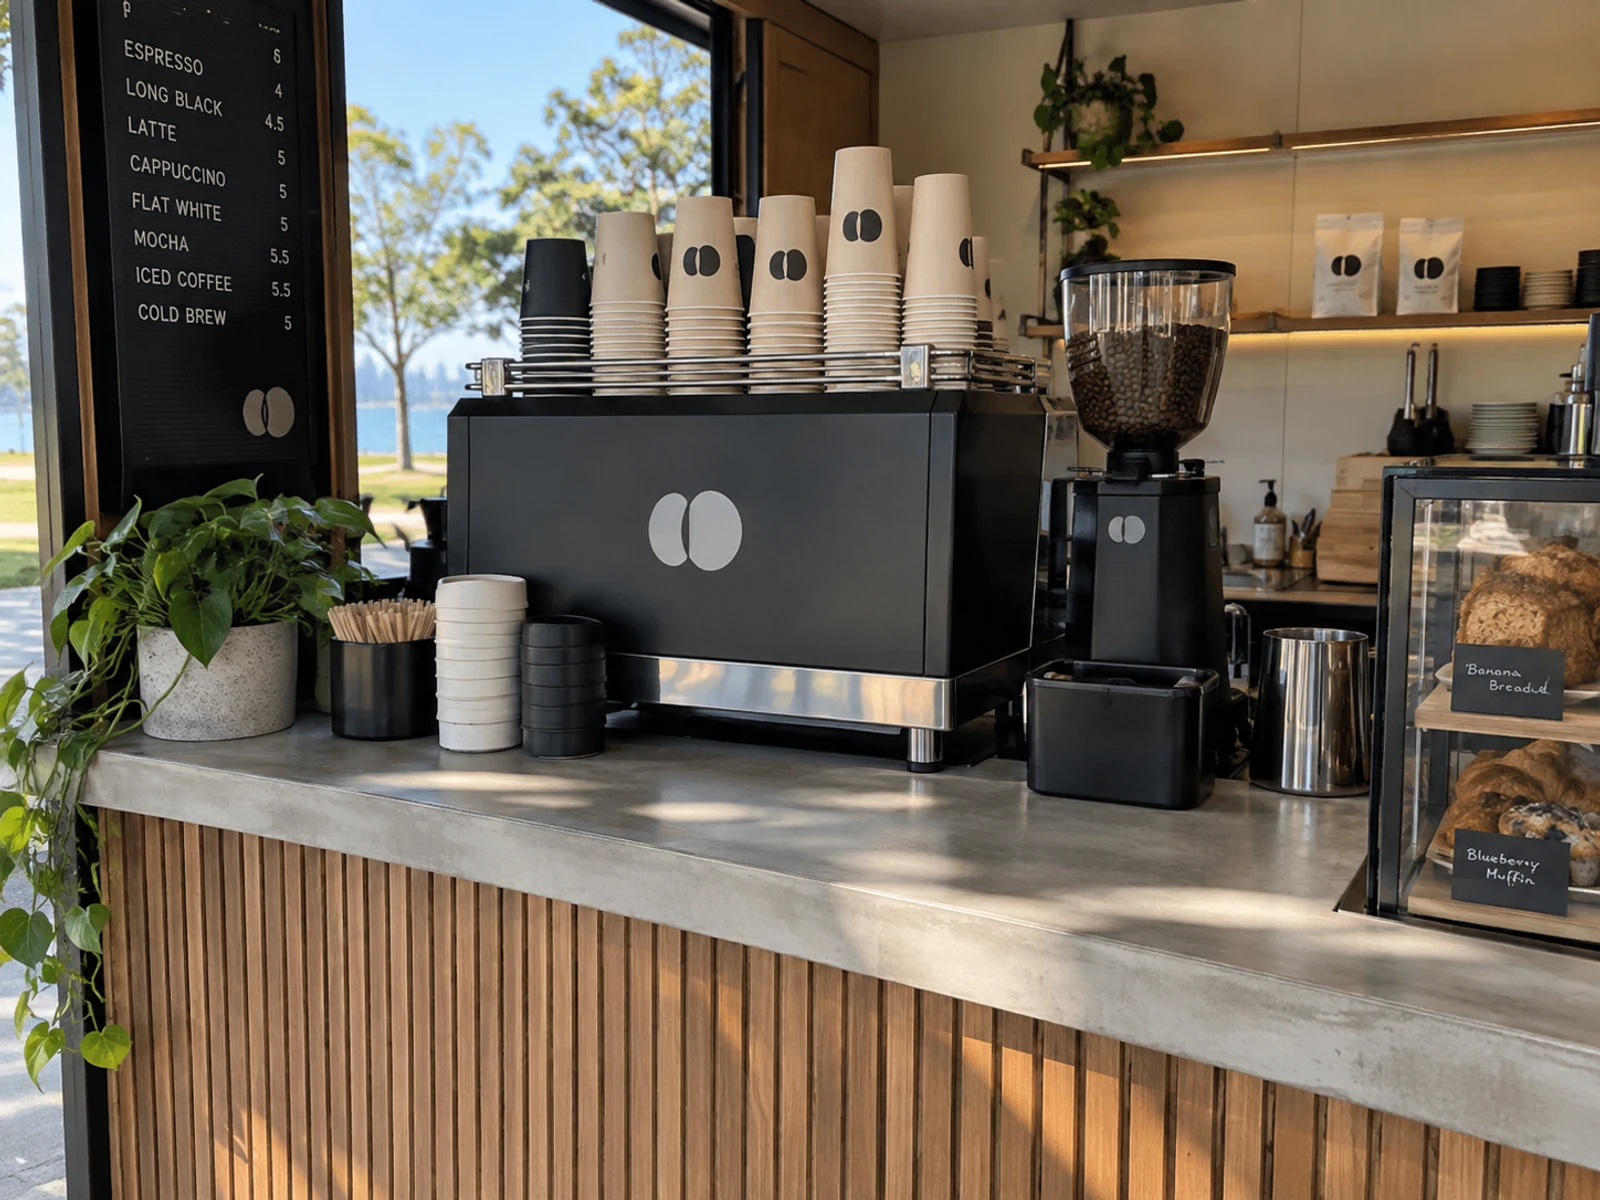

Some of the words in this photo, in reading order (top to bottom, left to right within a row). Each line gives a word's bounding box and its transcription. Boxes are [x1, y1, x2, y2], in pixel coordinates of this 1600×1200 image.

[124, 39, 204, 76] ESPRESSO
[274, 83, 283, 98] 4
[125, 77, 169, 104] LONG
[175, 89, 223, 117] BLACK
[264, 113, 284, 132] 4.5
[127, 115, 177, 142] LATTE
[277, 150, 286, 166] 5
[130, 154, 226, 188] CAPPUCCINO
[279, 183, 287, 199] 5
[132, 192, 171, 214] FLAT
[175, 198, 222, 222] WHITE
[280, 216, 289, 232] 5
[133, 229, 190, 252] MOCHA
[270, 248, 290, 265] 5.5
[135, 266, 172, 286] ICED
[177, 270, 233, 292] COFFEE
[271, 281, 292, 298] 5.5
[137, 303, 180, 323] COLD
[185, 307, 227, 326] BREW
[284, 315, 293, 331] 5
[1465, 662, 1522, 678] Banana
